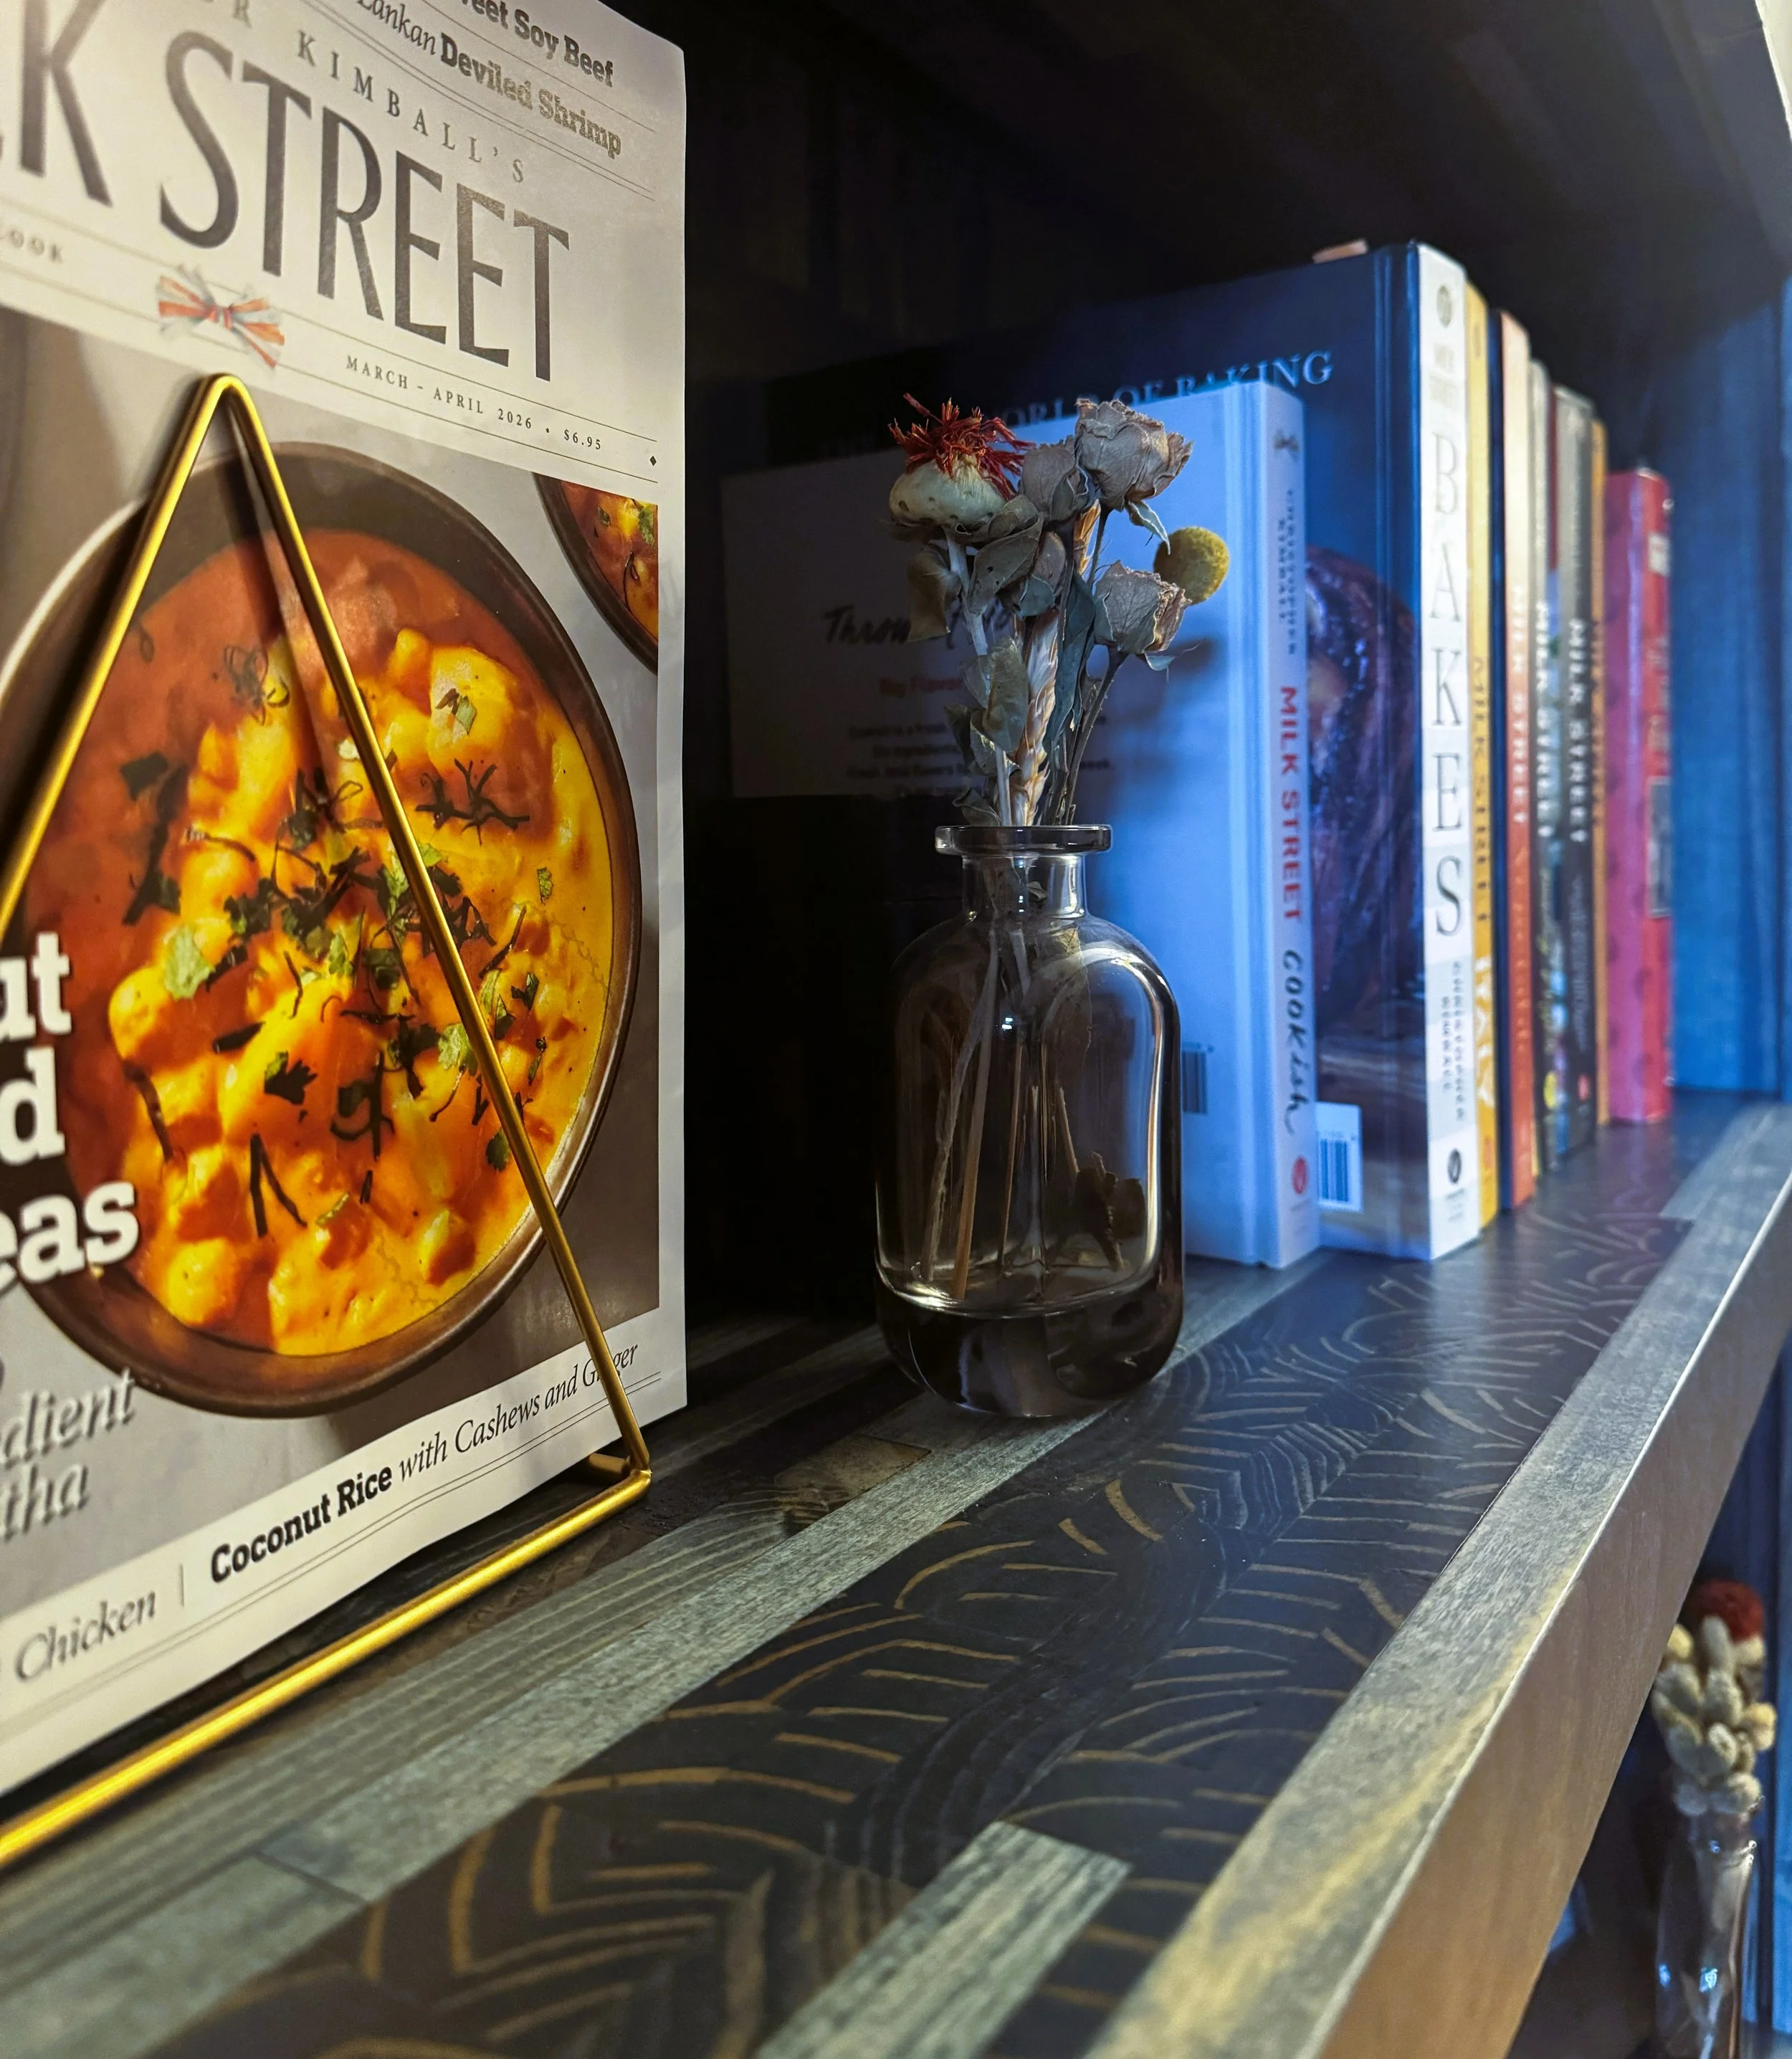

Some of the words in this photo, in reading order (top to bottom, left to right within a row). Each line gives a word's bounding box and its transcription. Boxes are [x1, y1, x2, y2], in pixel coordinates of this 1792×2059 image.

[297, 29, 525, 183] KIMBALL'S
[441, 32, 533, 110] Deviled
[538, 87, 621, 159] Shrimp
[462, 0, 508, 29] eet
[514, 9, 559, 59] Soy
[563, 34, 614, 87] Beef
[0, 226, 63, 264] OOK
[159, 29, 571, 381] STREET
[346, 354, 408, 390] MARCH
[433, 386, 484, 415] APRIL
[497, 406, 532, 430] 2026
[563, 429, 602, 451] $6.95
[1280, 685, 1301, 775] MILK
[1430, 432, 1463, 937] BAKES
[1281, 789, 1303, 920] STREET
[14, 1590, 156, 1683] Chicken
[209, 1496, 331, 1583] Coconut
[337, 1464, 394, 1517] Rice
[399, 1428, 448, 1481] with
[454, 1384, 541, 1453] Cashews
[544, 1363, 578, 1409] and
